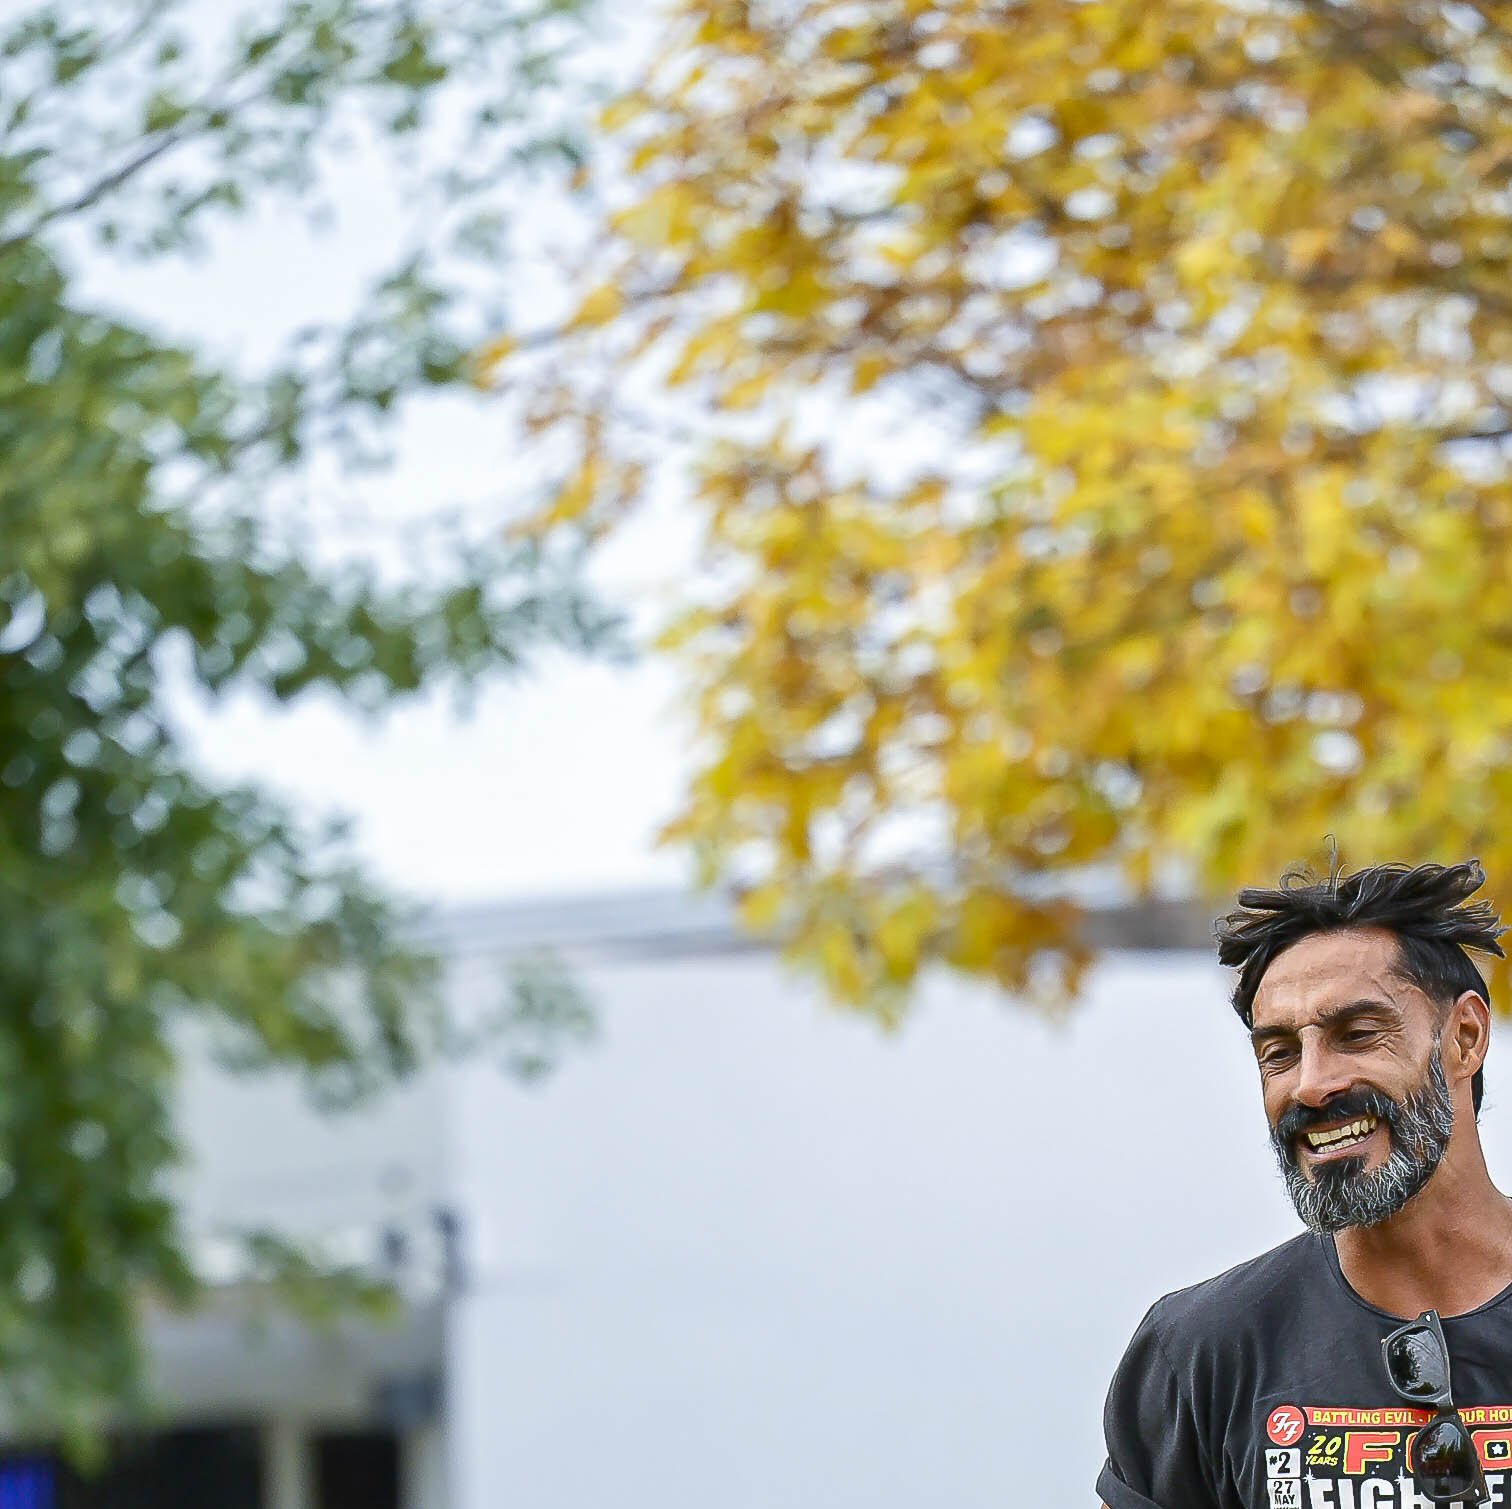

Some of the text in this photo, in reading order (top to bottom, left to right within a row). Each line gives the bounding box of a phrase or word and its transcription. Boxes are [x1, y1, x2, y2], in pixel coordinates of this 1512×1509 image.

[1313, 1411, 1381, 1424] BATTLING
[1384, 1412, 1415, 1424] EVIL
[1458, 1409, 1485, 1423] OUR
[1308, 1435, 1342, 1455] 20
[1269, 1451, 1291, 1474] #2
[1305, 1455, 1339, 1466] YEARS
[1273, 1480, 1293, 1494] 27
[1274, 1494, 1295, 1505] MAY
